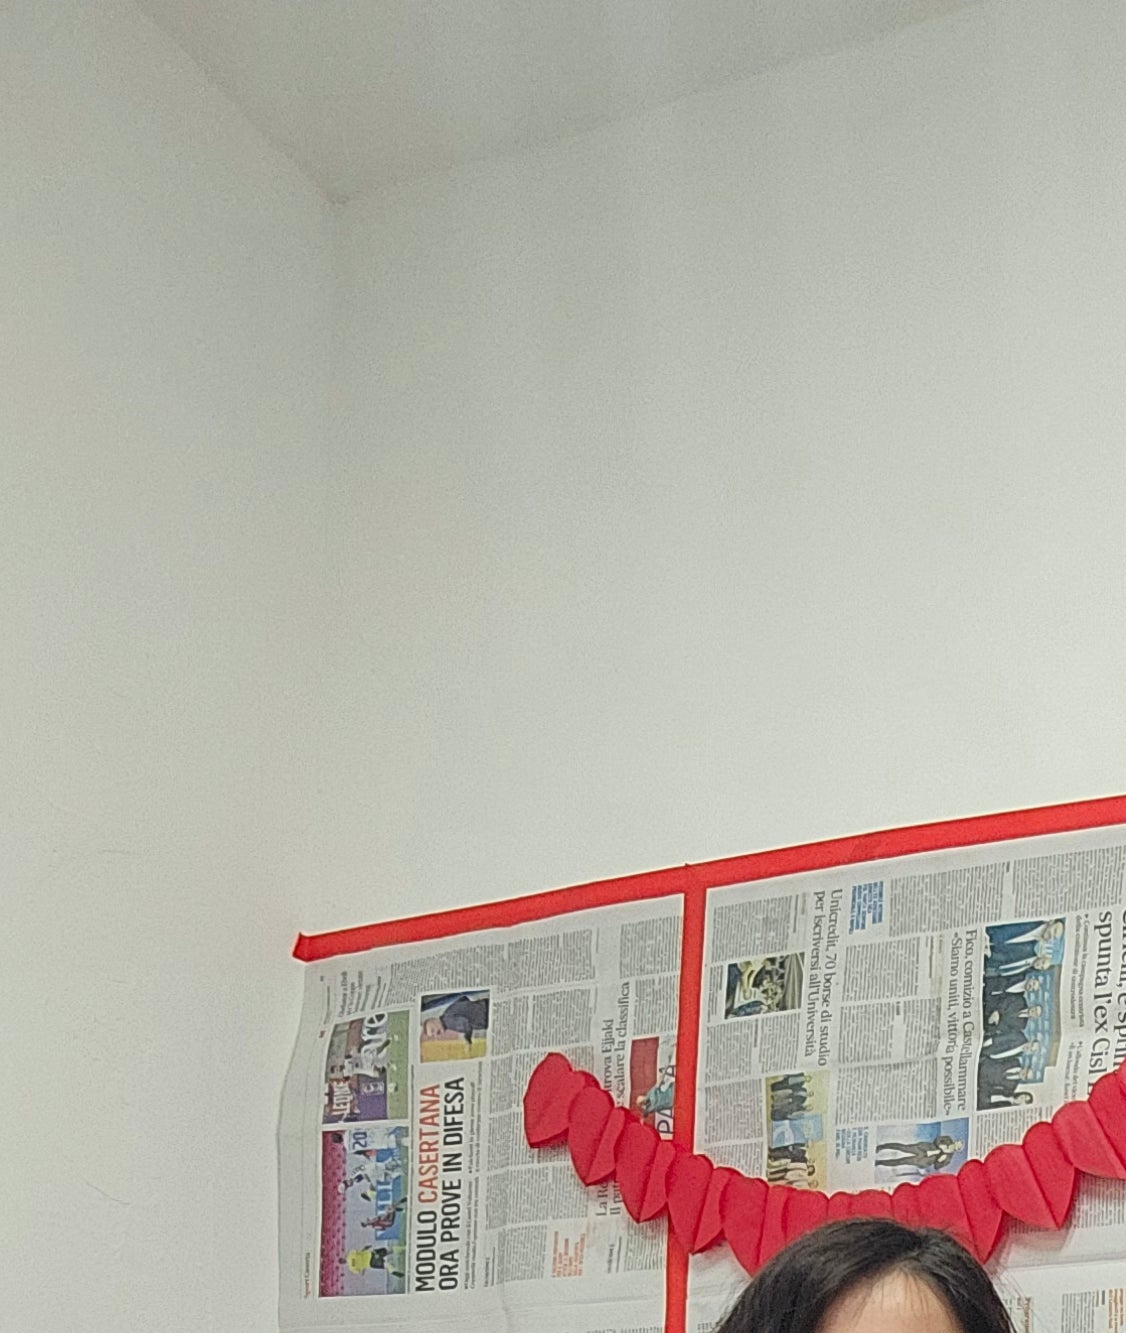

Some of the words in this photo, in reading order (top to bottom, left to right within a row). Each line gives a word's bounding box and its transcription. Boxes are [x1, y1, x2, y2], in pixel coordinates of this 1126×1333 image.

[964, 928, 977, 959] Fico,
[1094, 911, 1113, 985] spunta
[962, 959, 975, 1009] comizio
[1093, 992, 1112, 1032] l'ex
[962, 1010, 971, 1019] a
[956, 1020, 974, 1111] Castellammare
[443, 1077, 464, 1146] DIFESA
[417, 1084, 440, 1203] CASERTANA
[442, 1152, 462, 1172] IN
[441, 1179, 461, 1242] PROVE
[415, 1211, 437, 1292] MODULO
[438, 1249, 459, 1291] ORA
